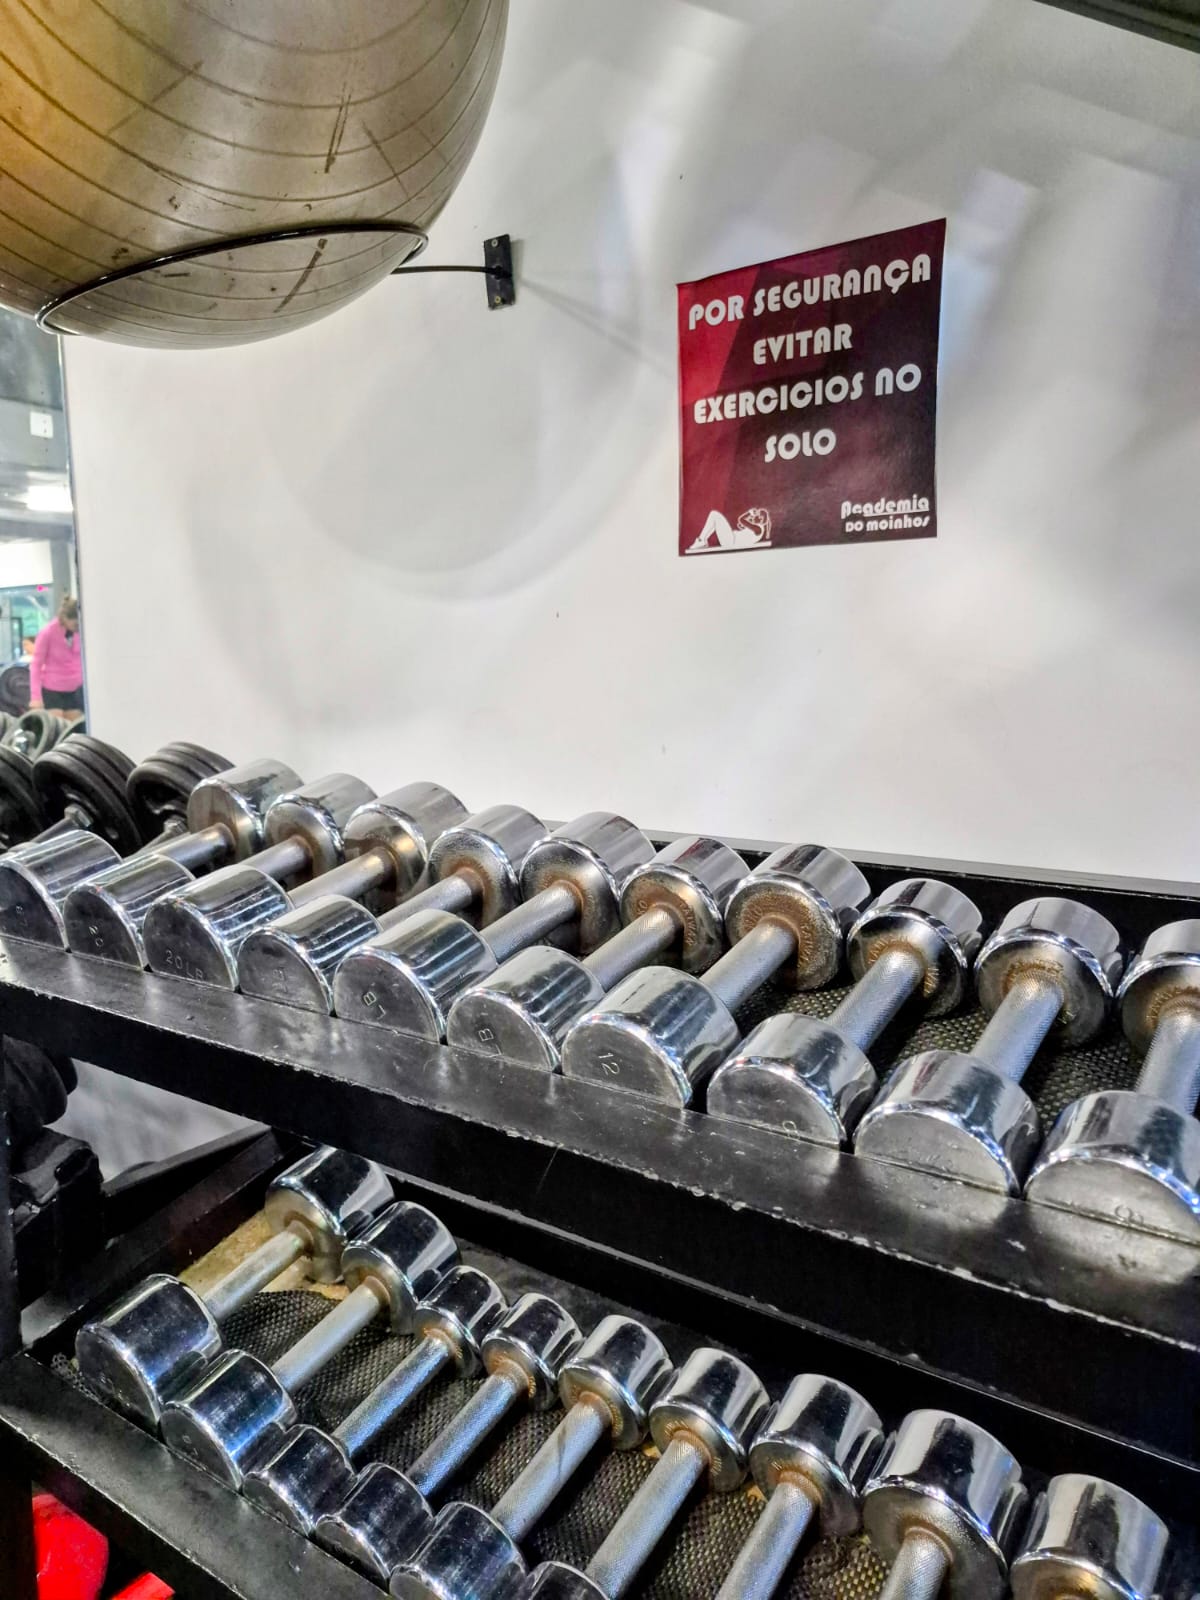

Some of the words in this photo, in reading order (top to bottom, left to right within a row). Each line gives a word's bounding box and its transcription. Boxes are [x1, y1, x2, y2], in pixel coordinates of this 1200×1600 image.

[688, 295, 744, 330] POR
[753, 254, 931, 316] SEGURANÇA
[753, 323, 853, 365] EVITAR
[693, 372, 864, 424] EXERCICIOS
[875, 363, 922, 396] NO
[764, 428, 837, 463] SOLO
[840, 493, 930, 520] Academia
[845, 520, 865, 533] DO
